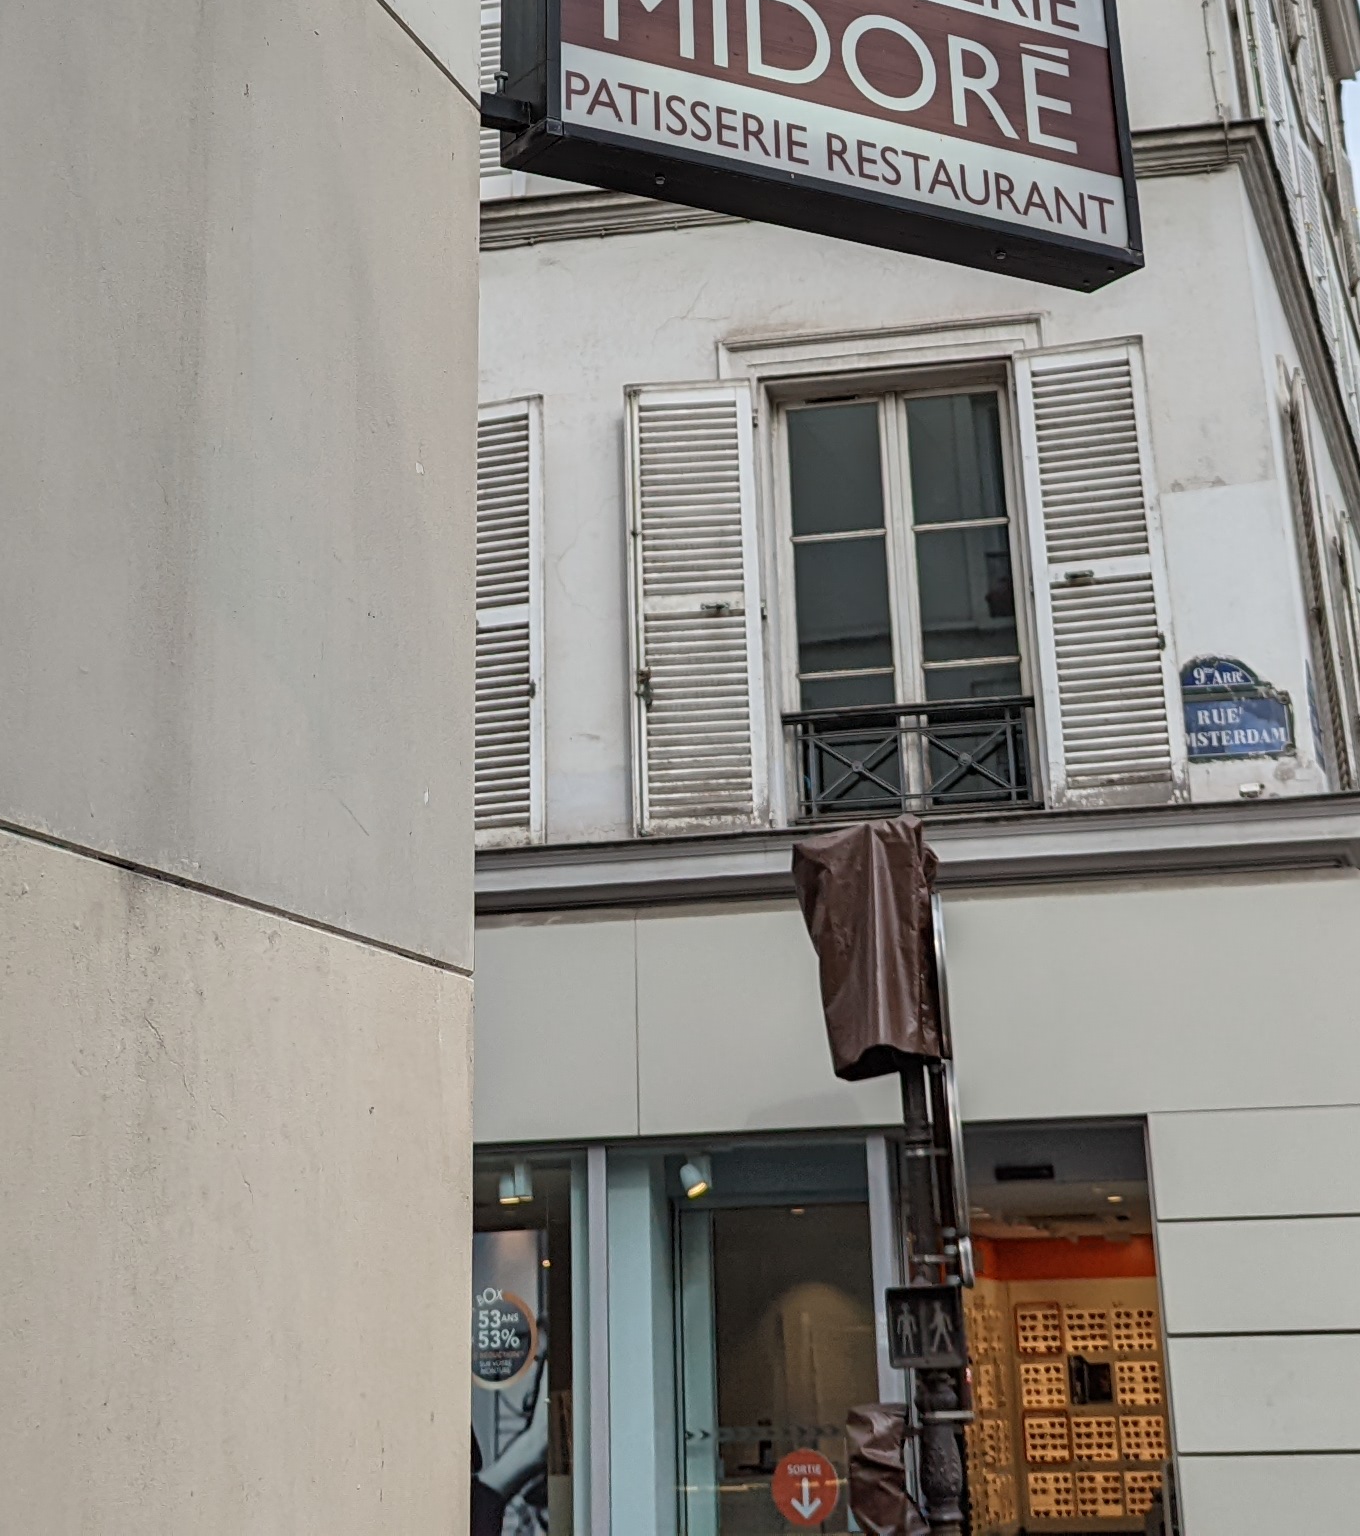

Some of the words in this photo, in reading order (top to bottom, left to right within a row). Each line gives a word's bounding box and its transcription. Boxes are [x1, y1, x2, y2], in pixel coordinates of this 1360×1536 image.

[564, 70, 810, 165] PATISSERIE
[826, 132, 1115, 235] RESTAURANT
[1196, 707, 1240, 726] RUE
[1185, 726, 1286, 748] MSTERDAM
[478, 1309, 501, 1329] 53
[501, 1312, 519, 1322] ANS
[478, 1327, 520, 1348] 53%
[787, 1463, 822, 1476] SORTIE
